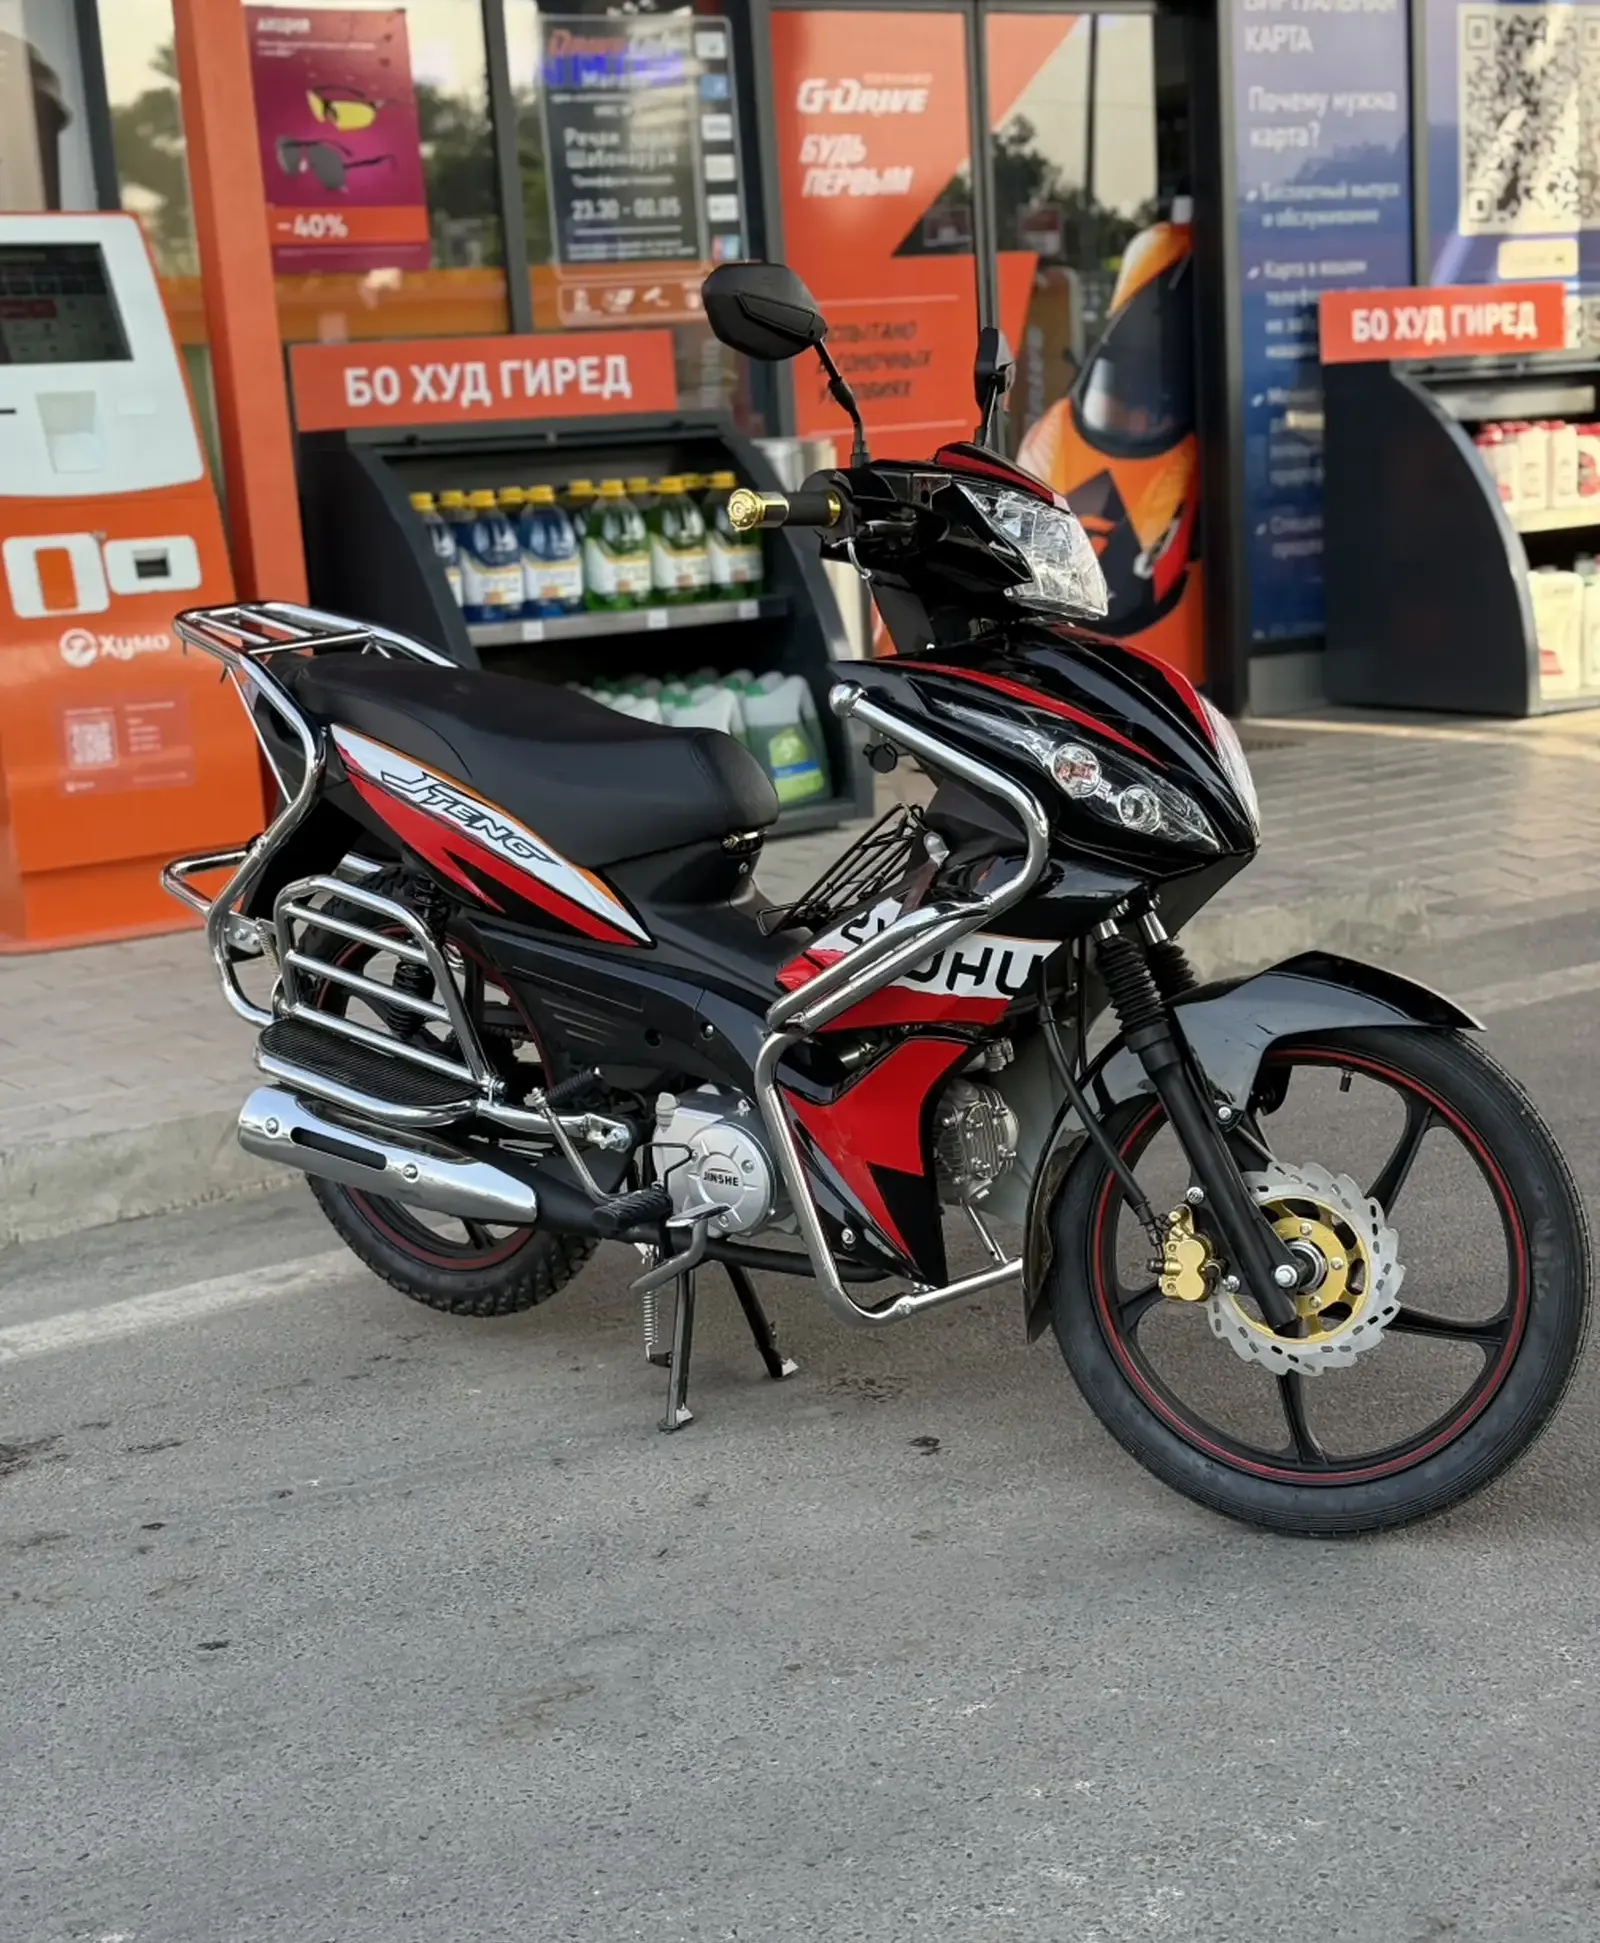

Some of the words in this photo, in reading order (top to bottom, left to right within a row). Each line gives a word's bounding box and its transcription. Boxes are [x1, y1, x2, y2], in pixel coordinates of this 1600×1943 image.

[1244, 24, 1314, 53] КАРТА
[1351, 308, 1390, 343] БО
[1394, 305, 1447, 345] ХУД
[1451, 301, 1538, 340] ГИРЕД
[344, 366, 401, 407] БО
[410, 361, 493, 408] ХУД
[500, 355, 632, 400] ГИРЕД
